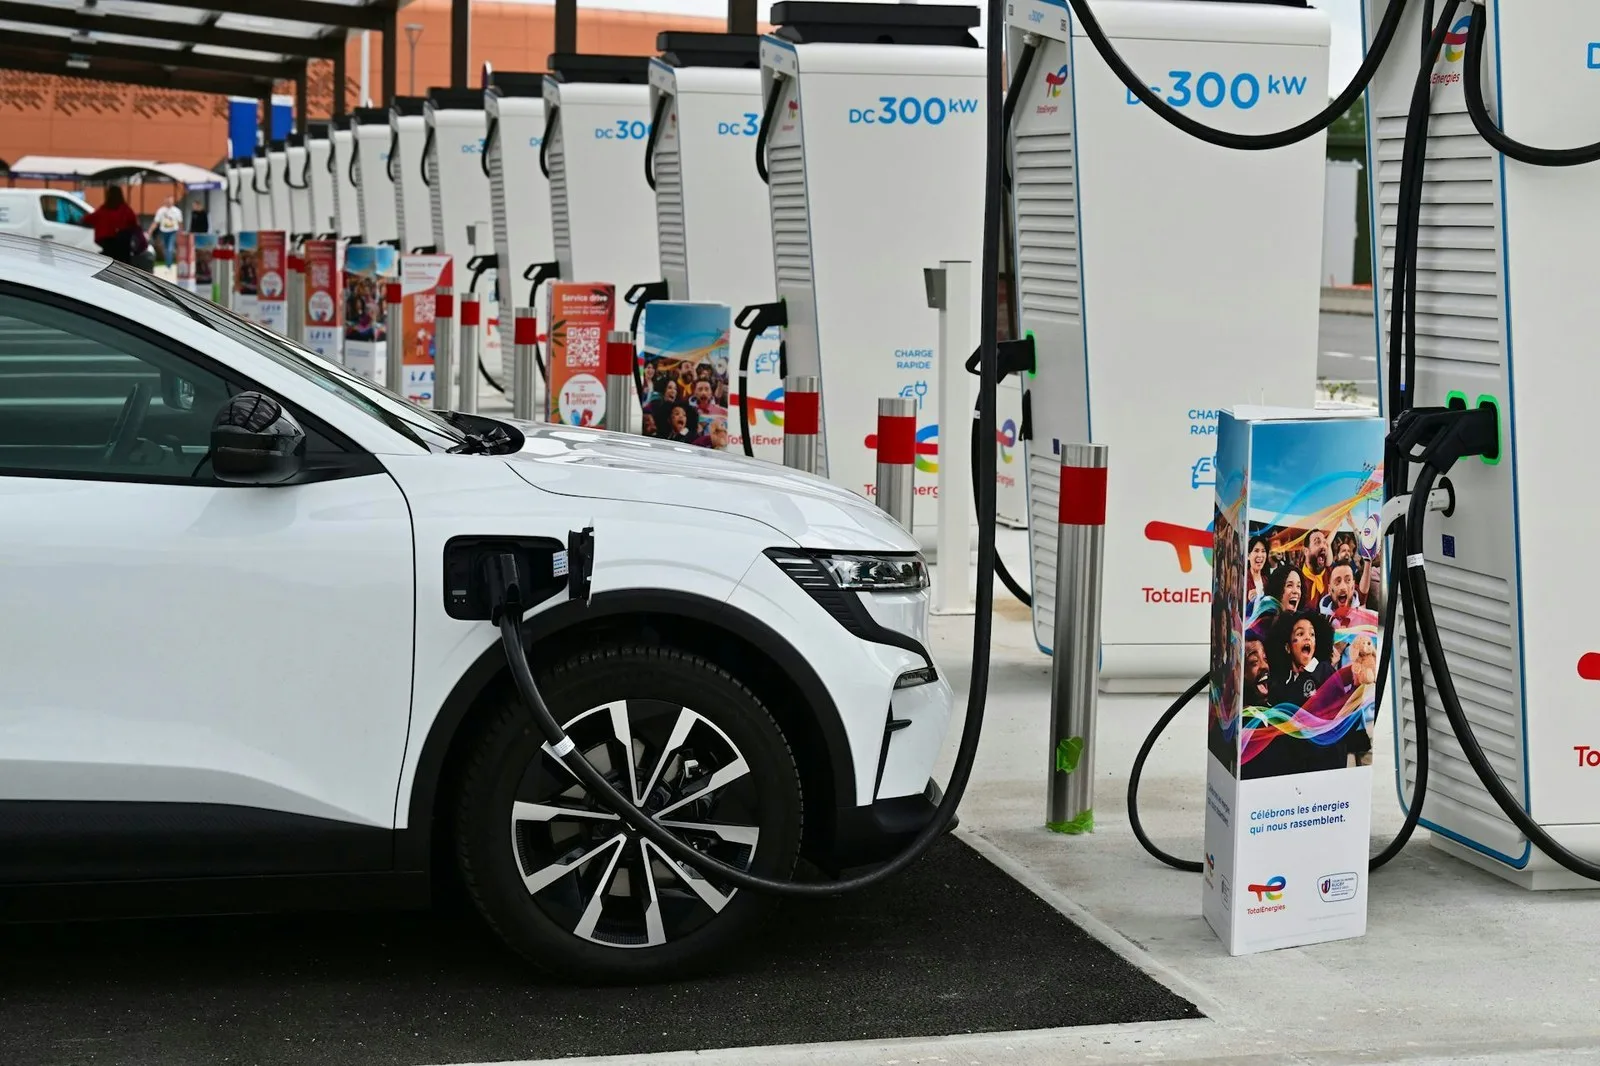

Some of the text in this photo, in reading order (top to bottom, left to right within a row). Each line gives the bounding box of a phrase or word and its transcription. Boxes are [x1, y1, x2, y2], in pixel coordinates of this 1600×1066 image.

[1166, 71, 1260, 109] 300
[1267, 74, 1307, 95] kW
[849, 97, 978, 125] DC 300 kW
[595, 121, 652, 140] DC 30
[718, 123, 740, 136] DC
[562, 293, 608, 302] Service drive
[894, 350, 933, 358] CHARGE
[1250, 801, 1350, 820] Célébrons les énergies
[1250, 814, 1346, 835] qui nous rassemblent.
[1247, 904, 1286, 914] TotalEnergies
